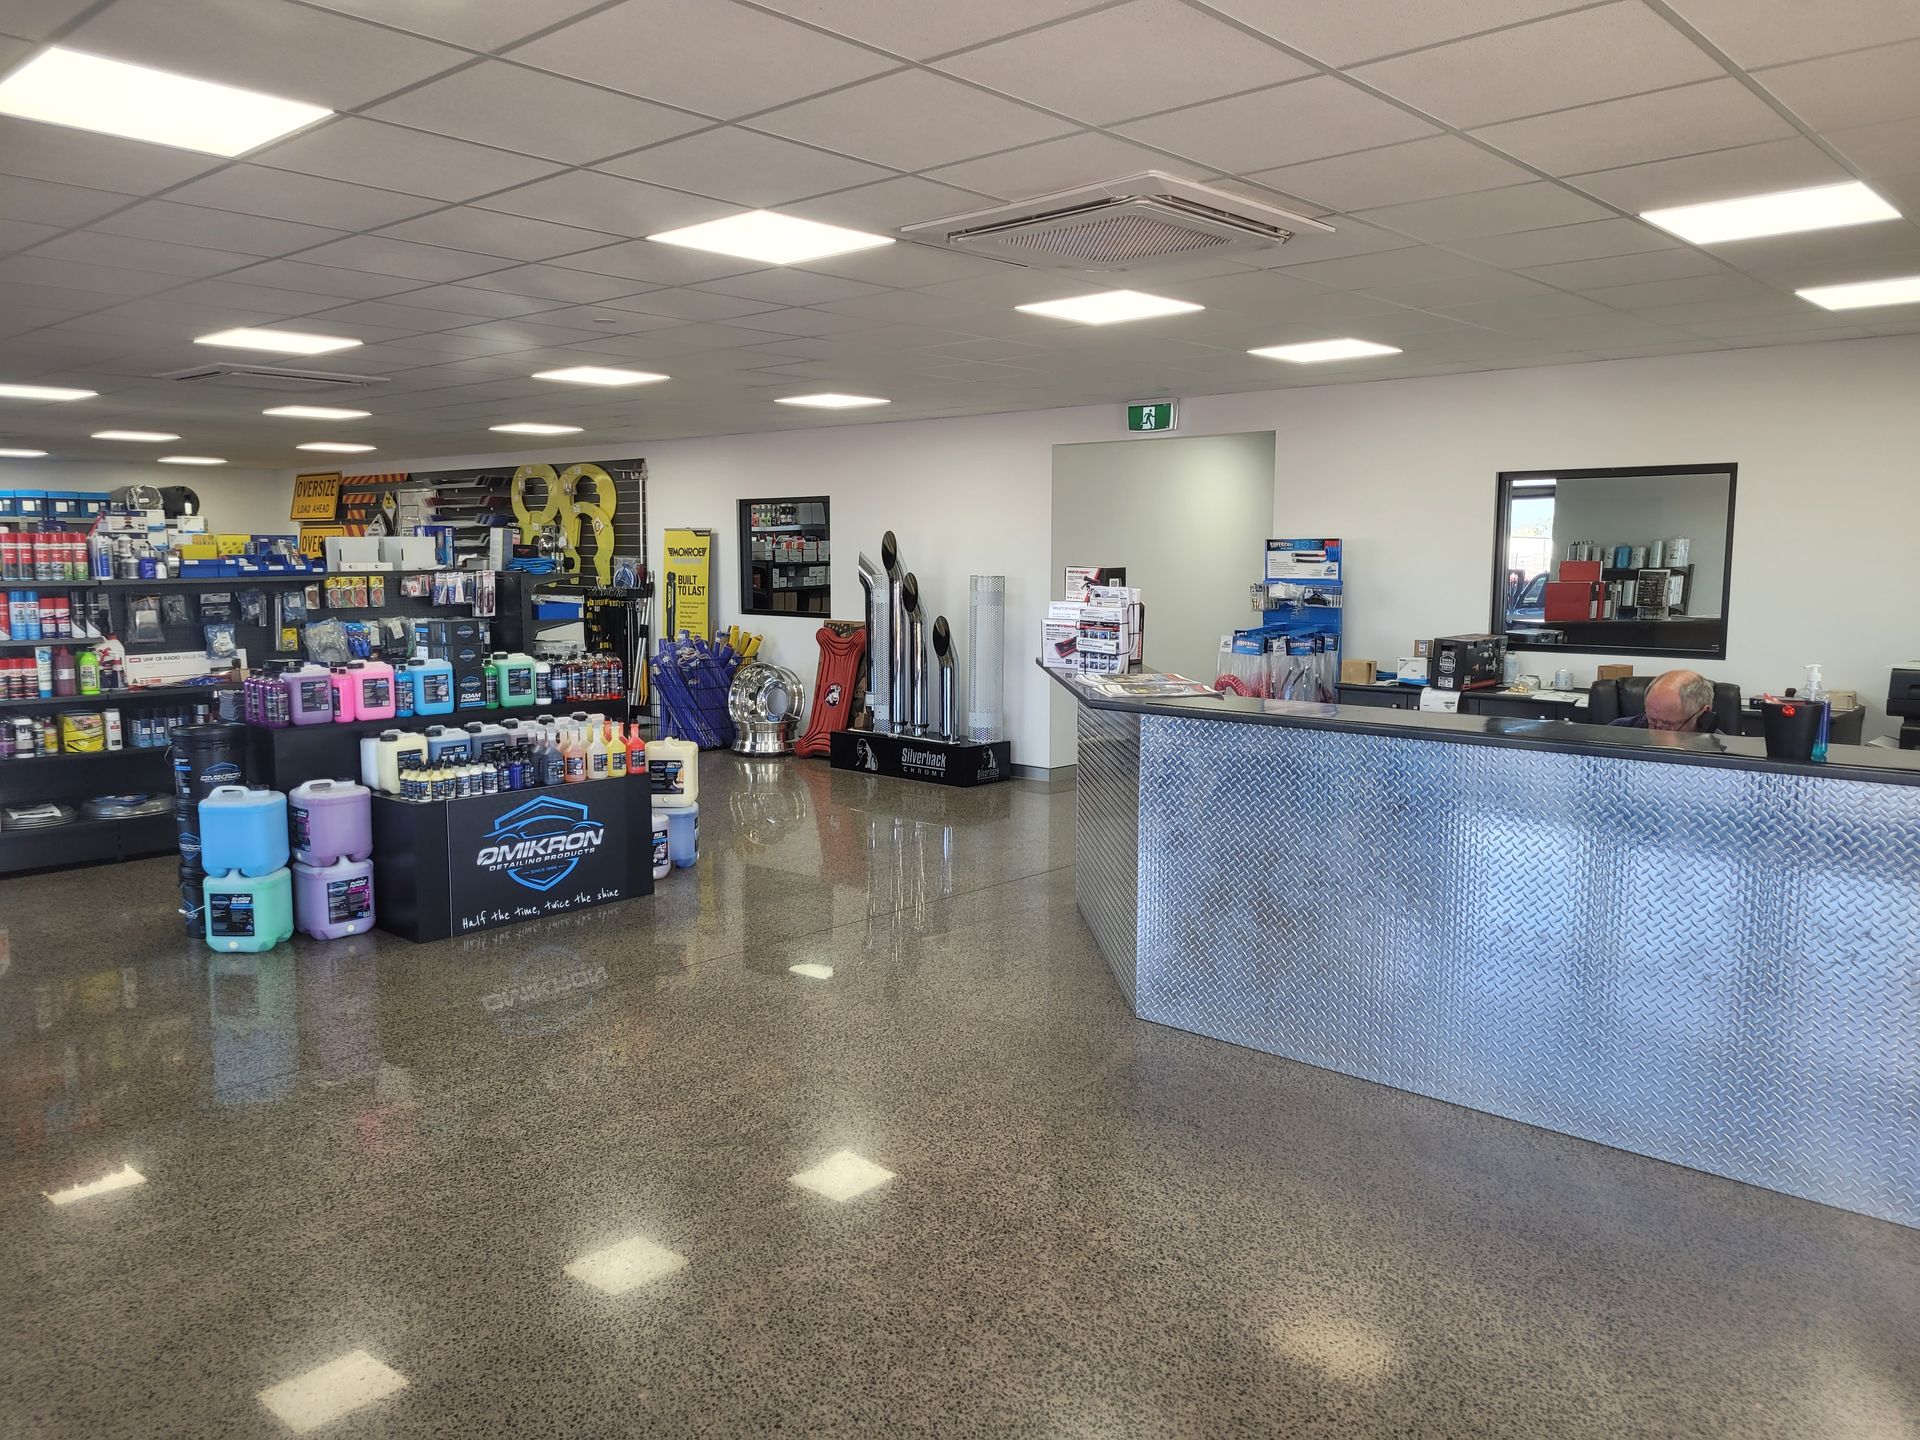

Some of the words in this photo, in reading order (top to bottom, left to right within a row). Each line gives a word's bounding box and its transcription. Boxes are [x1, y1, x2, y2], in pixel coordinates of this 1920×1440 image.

[296, 479, 336, 498] OVERSIZE
[297, 503, 311, 514] LOAD
[312, 503, 330, 513] AHEAD
[671, 547, 704, 557] MONROE
[678, 575, 698, 585] BUILT
[678, 586, 687, 596] TO
[688, 586, 706, 596] LAST
[901, 747, 946, 768] Silverback
[903, 766, 945, 778] CHROME
[476, 828, 605, 867] OMIKRON
[488, 857, 542, 872] DETAILING
[543, 847, 596, 862] PRODUCTS
[462, 911, 487, 930] Half
[491, 909, 511, 922] the
[514, 905, 541, 918] time,
[544, 898, 571, 911] twice
[574, 892, 592, 904] the
[597, 887, 620, 900] shine
